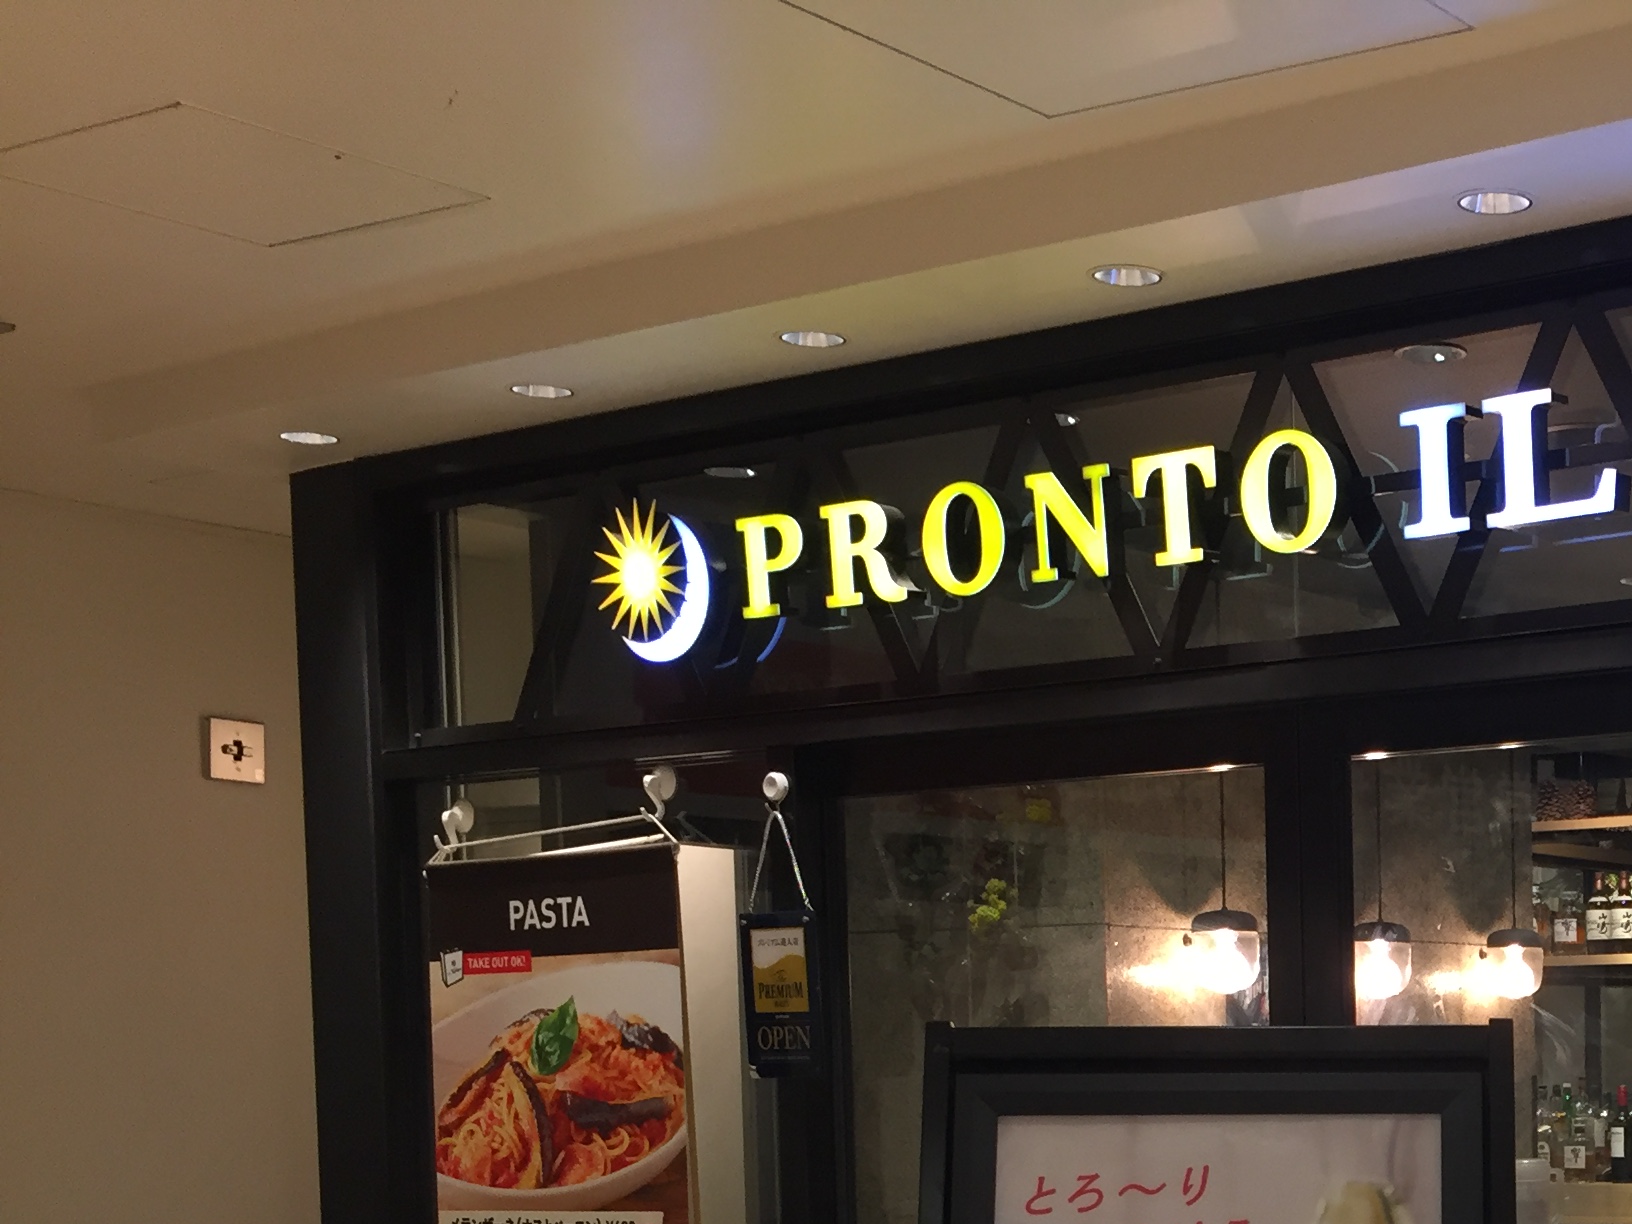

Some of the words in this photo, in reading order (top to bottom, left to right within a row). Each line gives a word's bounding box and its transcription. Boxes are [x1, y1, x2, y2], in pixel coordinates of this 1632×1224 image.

[737, 428, 1337, 618] PRONTO
[1400, 388, 1616, 538] IL
[509, 896, 590, 931] PASTA
[467, 957, 490, 969] TAKE
[491, 956, 508, 968] OUT
[757, 981, 804, 999] PREMIUM
[757, 1025, 812, 1051] OPEN
